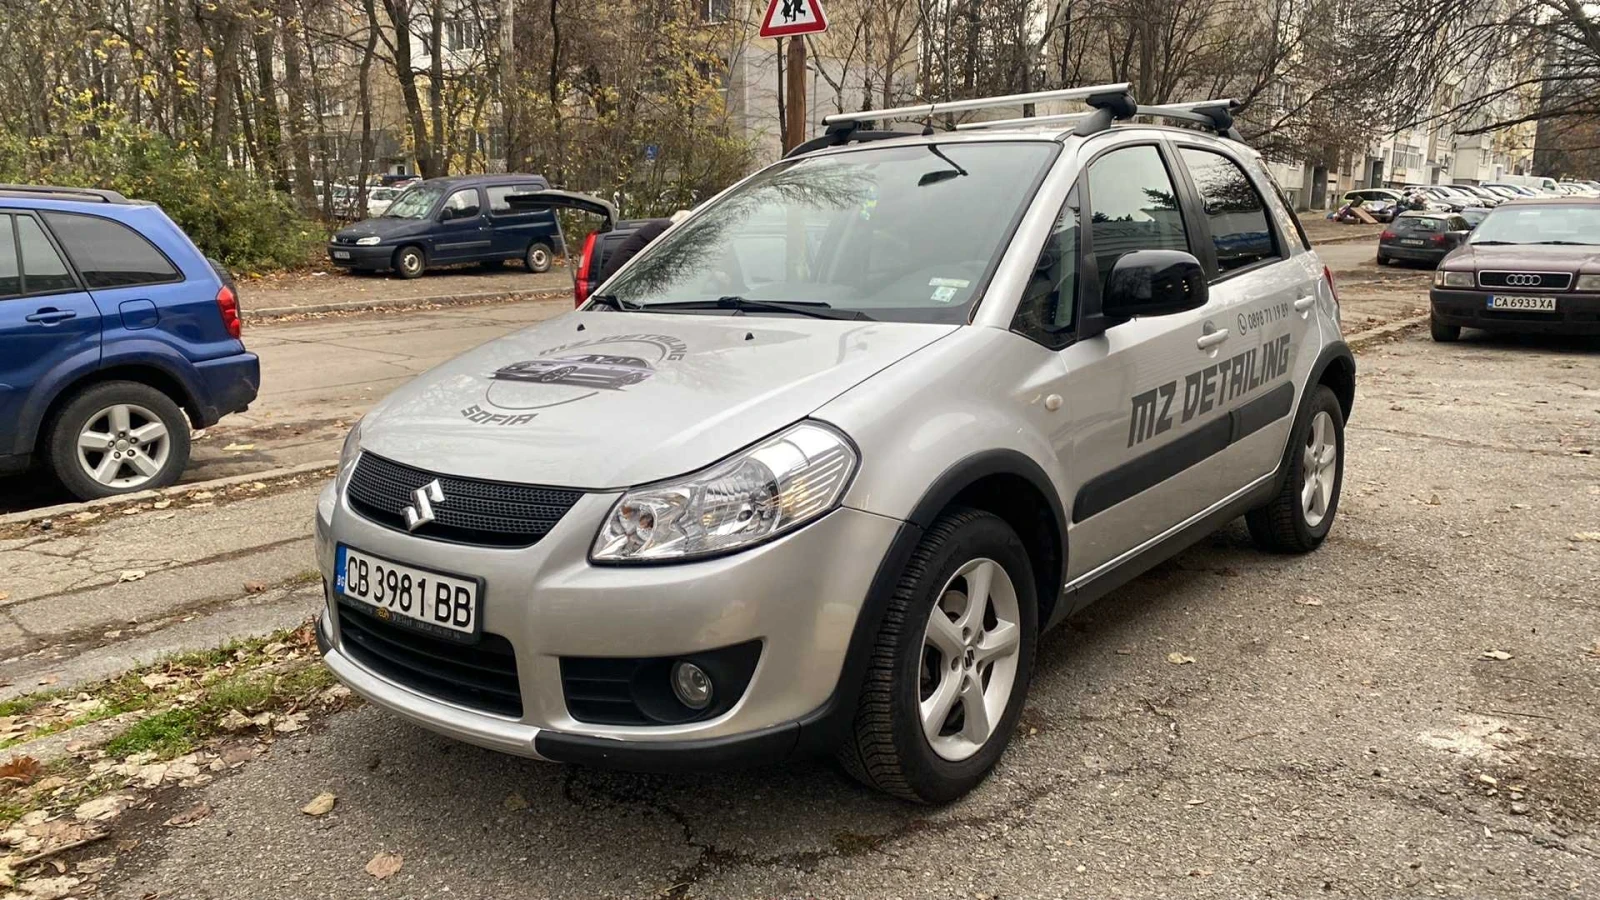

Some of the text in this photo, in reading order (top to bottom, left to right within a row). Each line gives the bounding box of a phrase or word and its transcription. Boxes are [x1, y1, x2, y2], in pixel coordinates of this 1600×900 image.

[1247, 302, 1289, 330] 0898 71 19 89
[1494, 297, 1553, 309] CA 6933 XA
[1127, 333, 1291, 449] MZ DETAILING
[460, 404, 539, 426] SOFIA
[336, 574, 345, 587] BG
[347, 556, 369, 597] CB
[373, 565, 427, 617] 3981
[434, 581, 471, 628] BB
